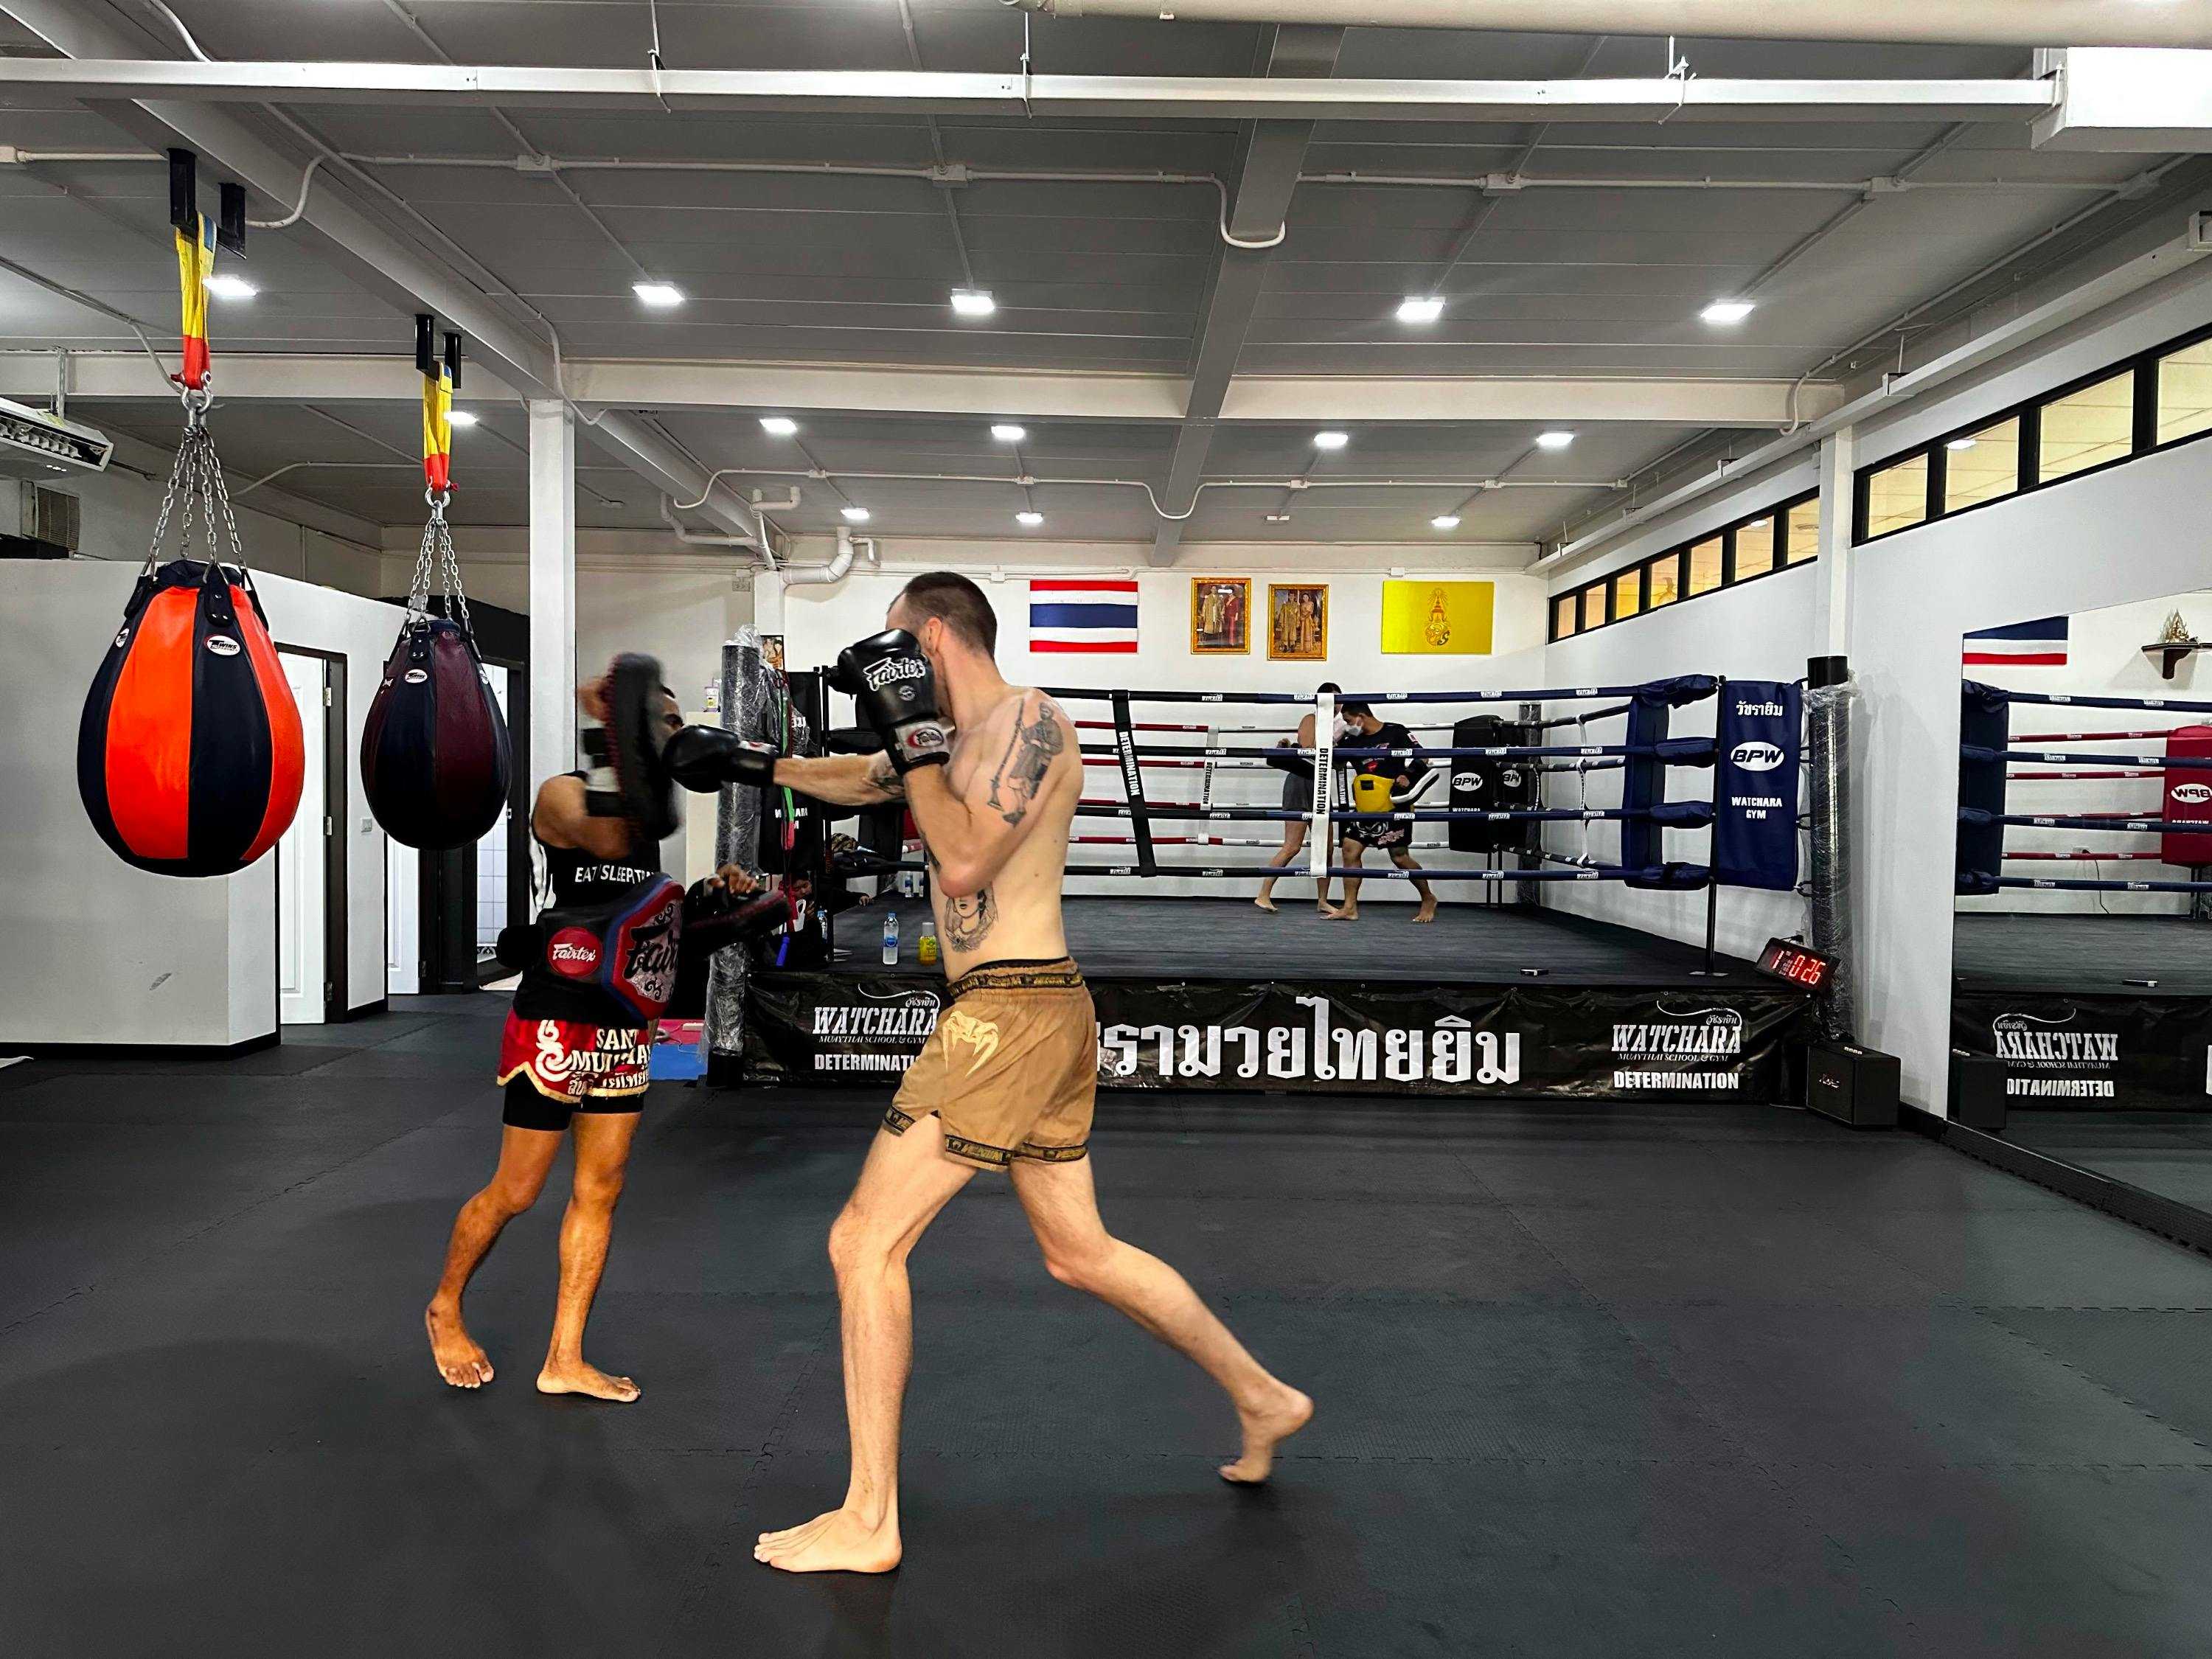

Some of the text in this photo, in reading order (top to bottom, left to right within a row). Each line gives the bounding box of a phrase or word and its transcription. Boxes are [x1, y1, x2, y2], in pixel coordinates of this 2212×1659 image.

[209, 639, 237, 650] TWINS
[1119, 731, 1141, 796] DETERMINATION
[1732, 749, 1783, 762] BPW
[1316, 748, 1329, 815] DETERMINATION
[1453, 777, 1482, 786] BPW
[1731, 796, 1783, 807] WATCHARA
[1745, 810, 1767, 819] GYM
[552, 943, 597, 962] Fairtex
[813, 1007, 939, 1035] WATCHARA
[899, 1036, 906, 1044] &
[1096, 996, 1520, 1085] รามวยไทยยิม
[1611, 1024, 1742, 1054] WATCHARA
[815, 1054, 918, 1071] DETERMINATI
[1618, 1053, 1663, 1061] MUAYTHAI
[1664, 1054, 1699, 1062] SCHOOL
[1613, 1071, 1739, 1089] DETERMINATION
